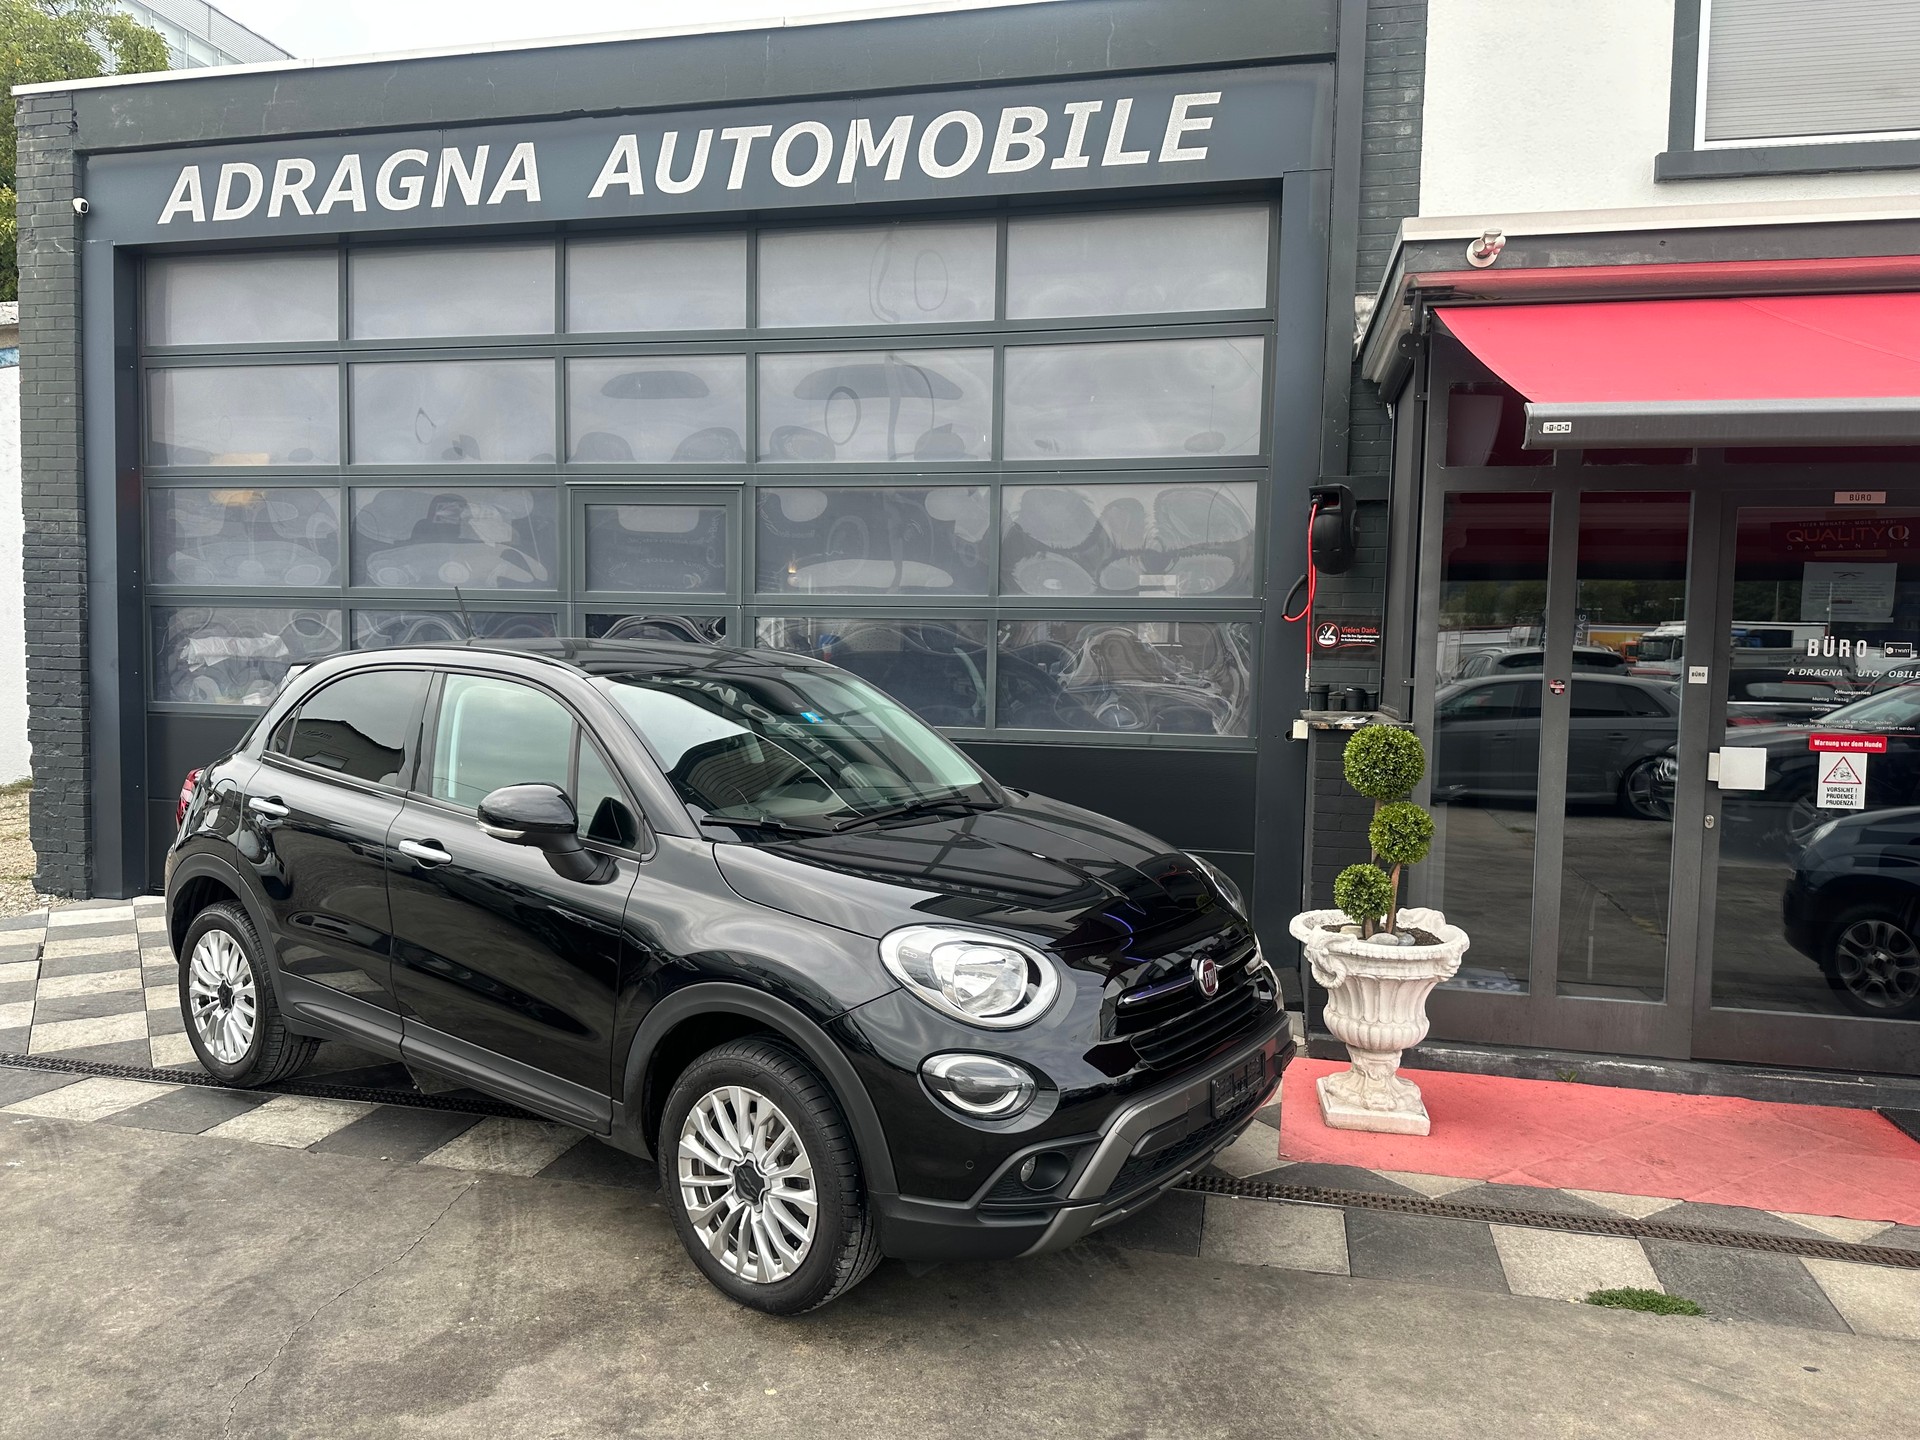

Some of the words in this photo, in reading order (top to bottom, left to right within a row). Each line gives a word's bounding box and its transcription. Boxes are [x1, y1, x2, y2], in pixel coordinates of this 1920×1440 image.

[157, 142, 542, 225] ADRAGNA
[588, 91, 1222, 198] AUTOMOBILE
[1849, 493, 1872, 502] BÜRO
[1786, 527, 1886, 542] QUALITY
[1807, 636, 1868, 658] BÜRO
[1691, 670, 1706, 678] BÜRO
[1813, 739, 1840, 748] Warnung
[1825, 792, 1854, 800] PRUDENCE
